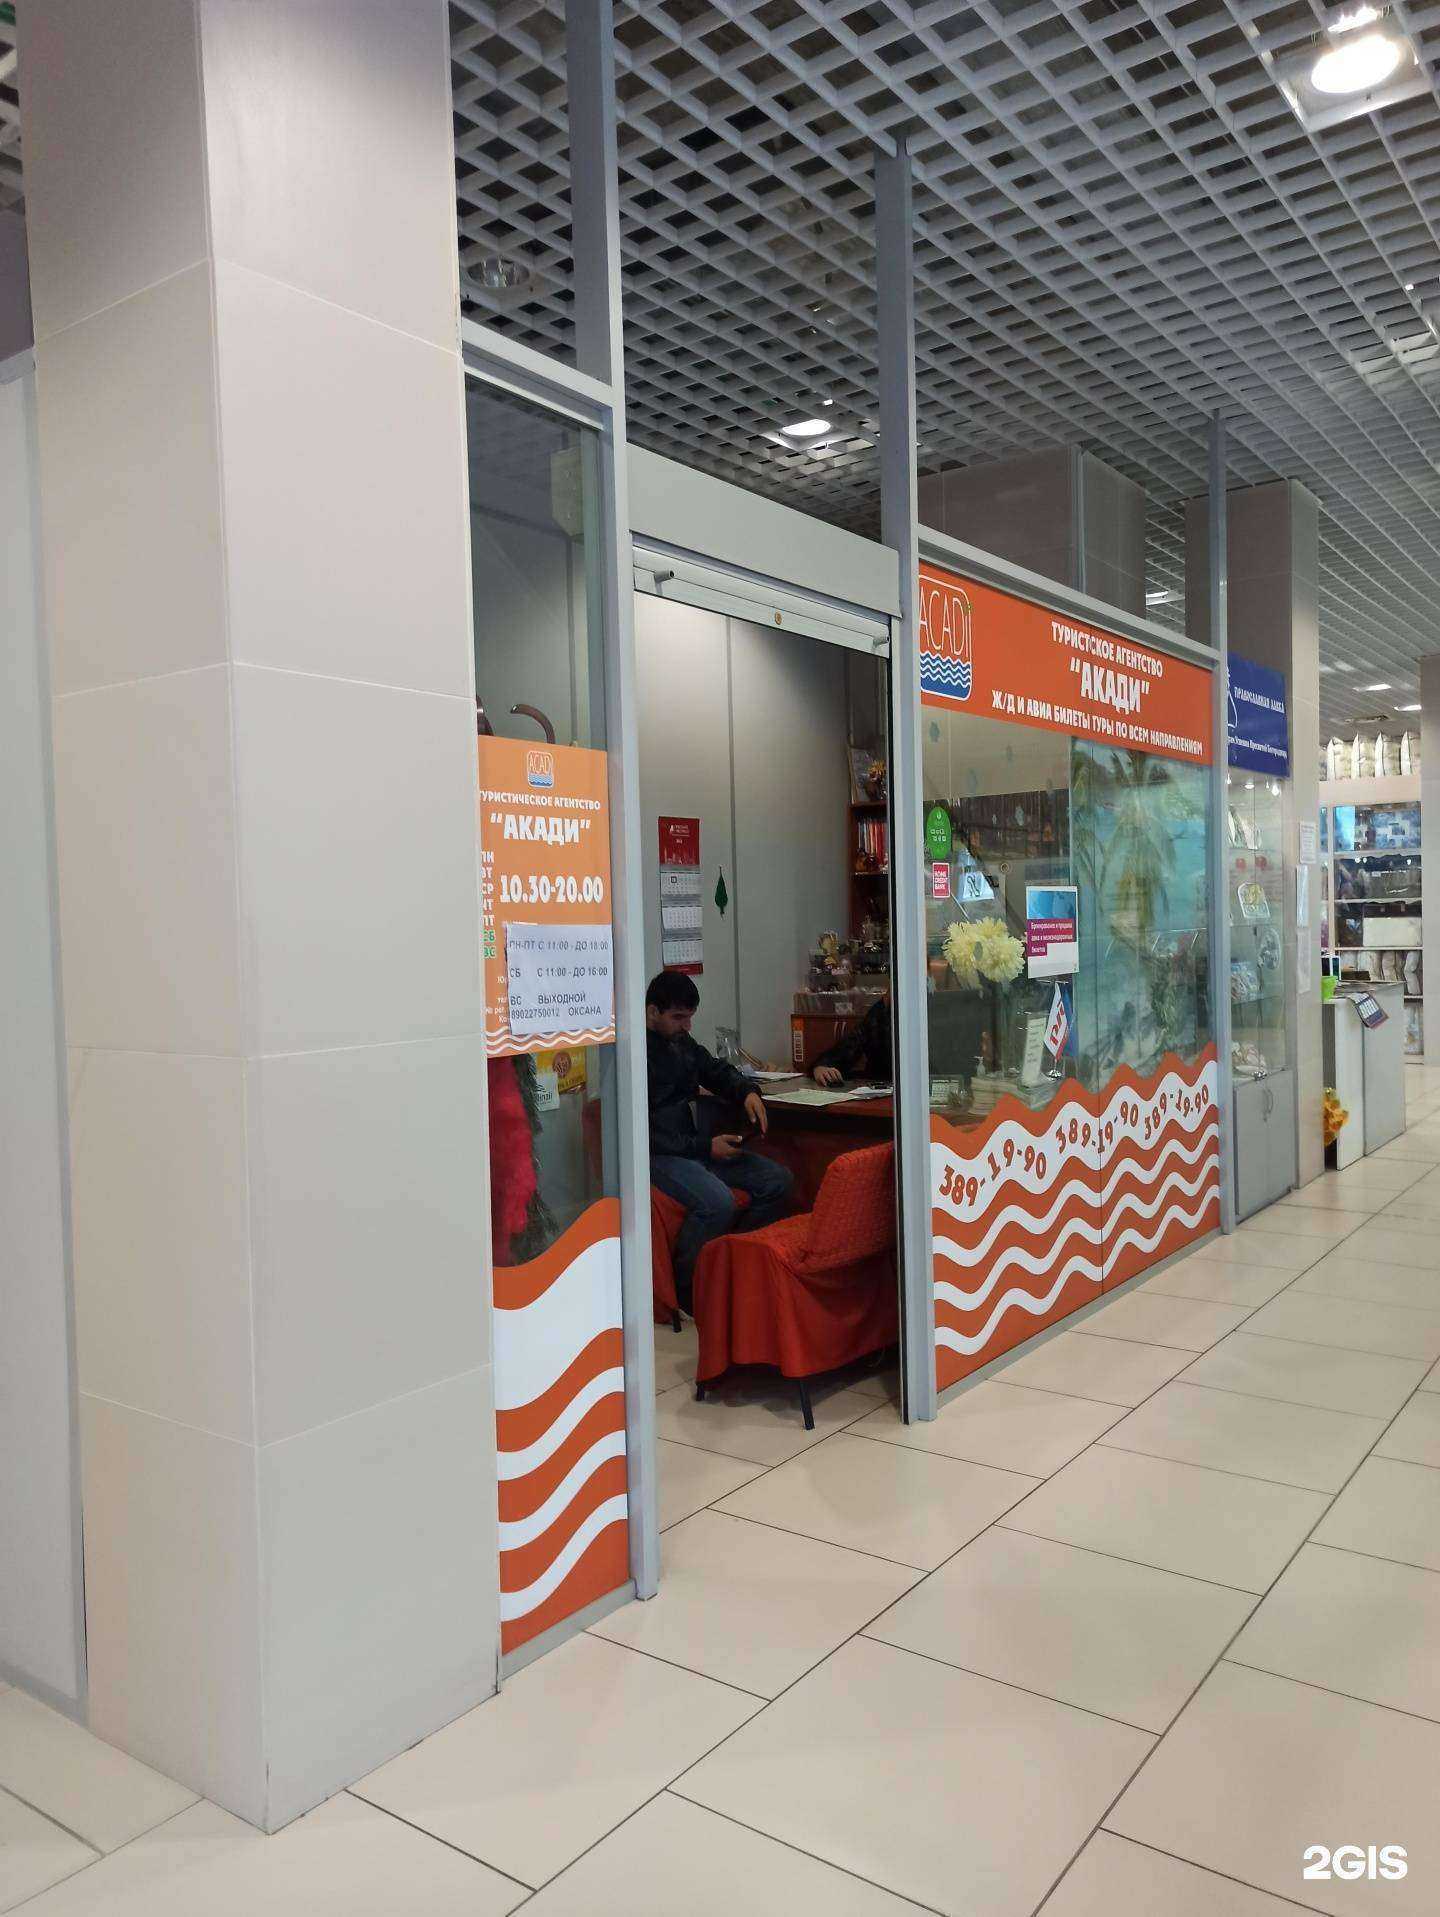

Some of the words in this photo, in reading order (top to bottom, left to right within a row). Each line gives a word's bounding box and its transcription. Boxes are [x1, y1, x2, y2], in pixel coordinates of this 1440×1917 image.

[1051, 621, 1115, 663] ТУРИСТСКОЕ
[1116, 645, 1163, 678] АГЕНТСТВО
[1070, 656, 1150, 715] "АКАДИ"
[991, 689, 1016, 715] Ж/Д
[1017, 695, 1025, 715] И
[1026, 697, 1053, 721] АВИА
[1053, 704, 1091, 730] БИЛЕТЫ
[1091, 715, 1114, 736] ТУРЫ
[1115, 721, 1130, 740] ПО
[1129, 724, 1150, 744] ВСЕМ
[554, 796, 601, 811] АГЕНТСТВО
[490, 812, 592, 846] "АКАДИ"
[500, 874, 604, 904] 10.30-20.00
[509, 940, 536, 950] ПН-ПТ
[537, 940, 545, 950] С
[547, 940, 569, 950] 11:00
[574, 940, 587, 951] ДО
[589, 940, 609, 950] 18:00
[510, 968, 521, 978] СБ
[537, 967, 543, 977] С
[546, 967, 567, 977] 11:00
[573, 966, 586, 978] ДО
[588, 966, 608, 976] 16:00
[510, 995, 522, 1006] ВС
[538, 991, 586, 1005] ВЫХОДНОЙ
[568, 1005, 602, 1016] ОКСАНА
[938, 1137, 1048, 1207] 389-19-90
[1055, 1100, 1140, 1155] 389-19-90
